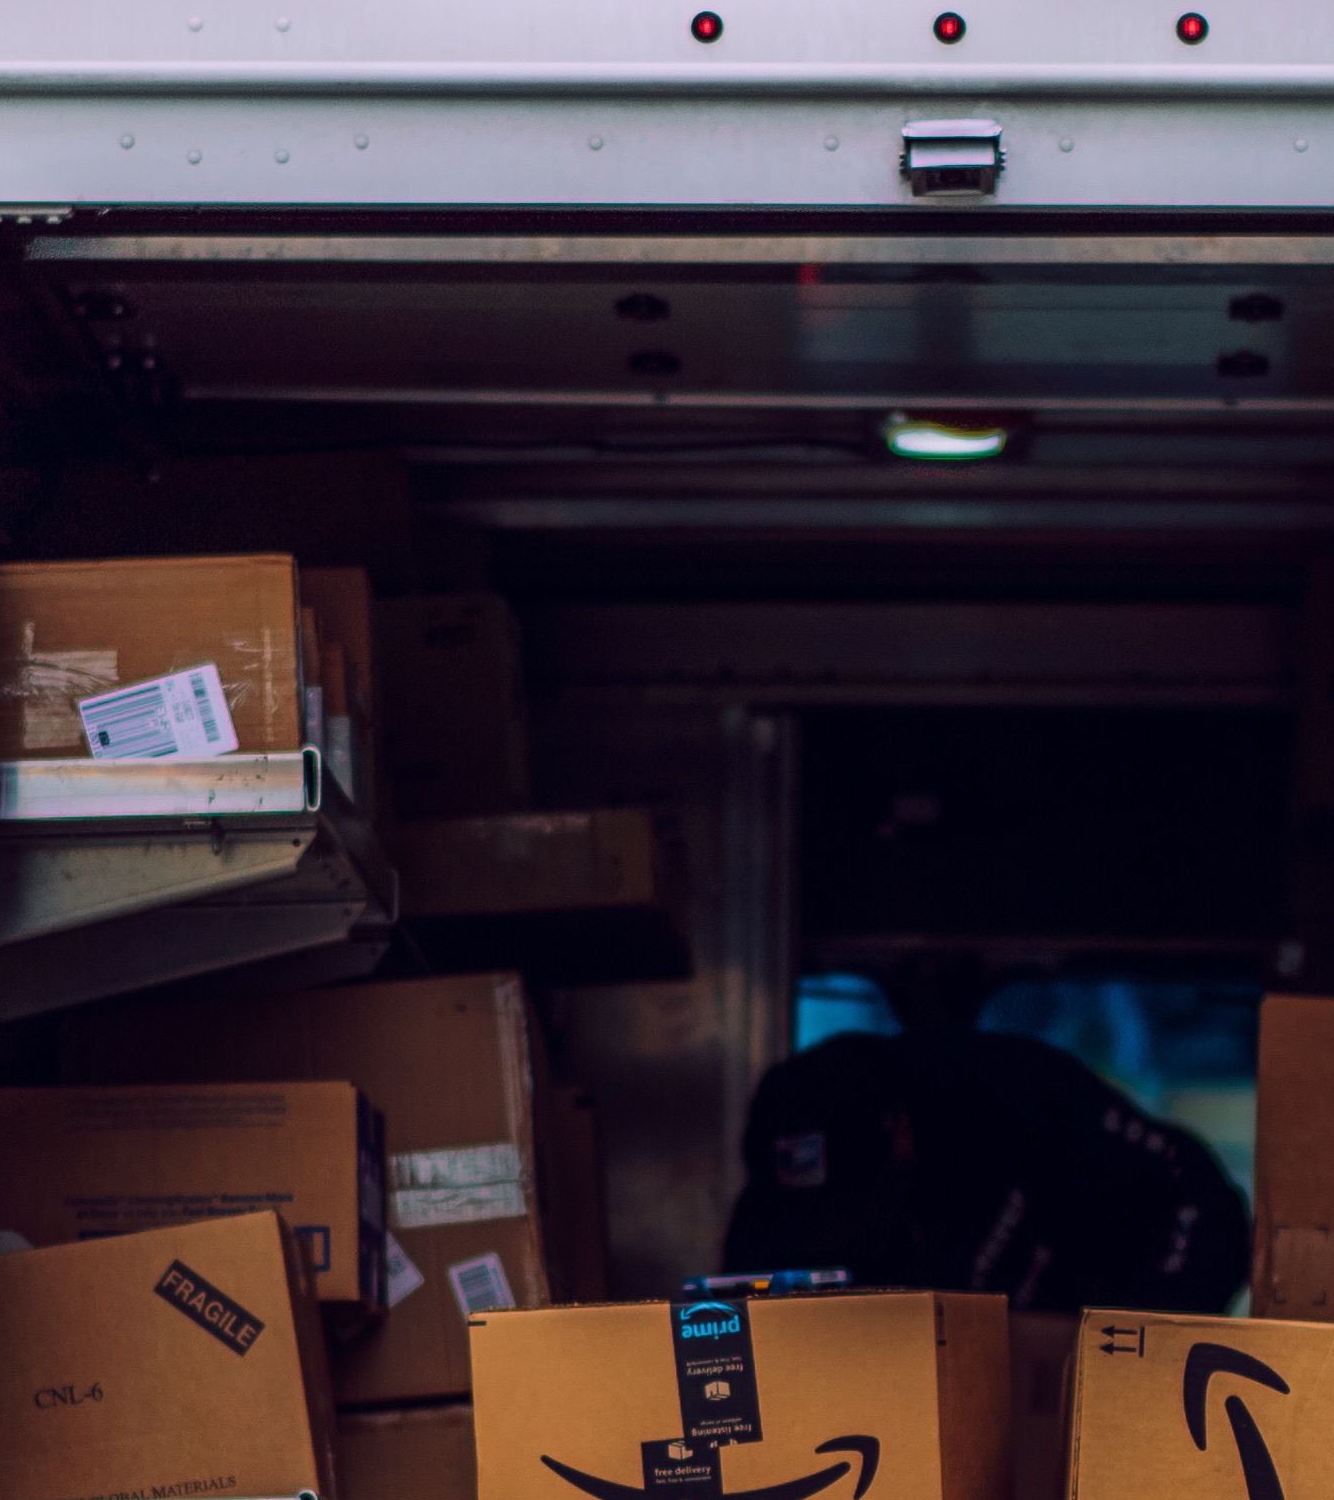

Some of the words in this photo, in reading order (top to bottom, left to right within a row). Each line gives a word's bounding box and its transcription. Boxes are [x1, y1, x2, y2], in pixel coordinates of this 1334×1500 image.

[161, 1269, 257, 1347] FRAGILE
[680, 1314, 741, 1340] prime
[686, 1366, 723, 1376] delivery
[725, 1362, 744, 1372] free
[33, 1382, 104, 1410] CNL-6
[690, 1426, 731, 1437] listening
[733, 1423, 752, 1433] free
[654, 1468, 673, 1477] free
[674, 1465, 711, 1476] delivery
[151, 1475, 237, 1499] MATERIALS
